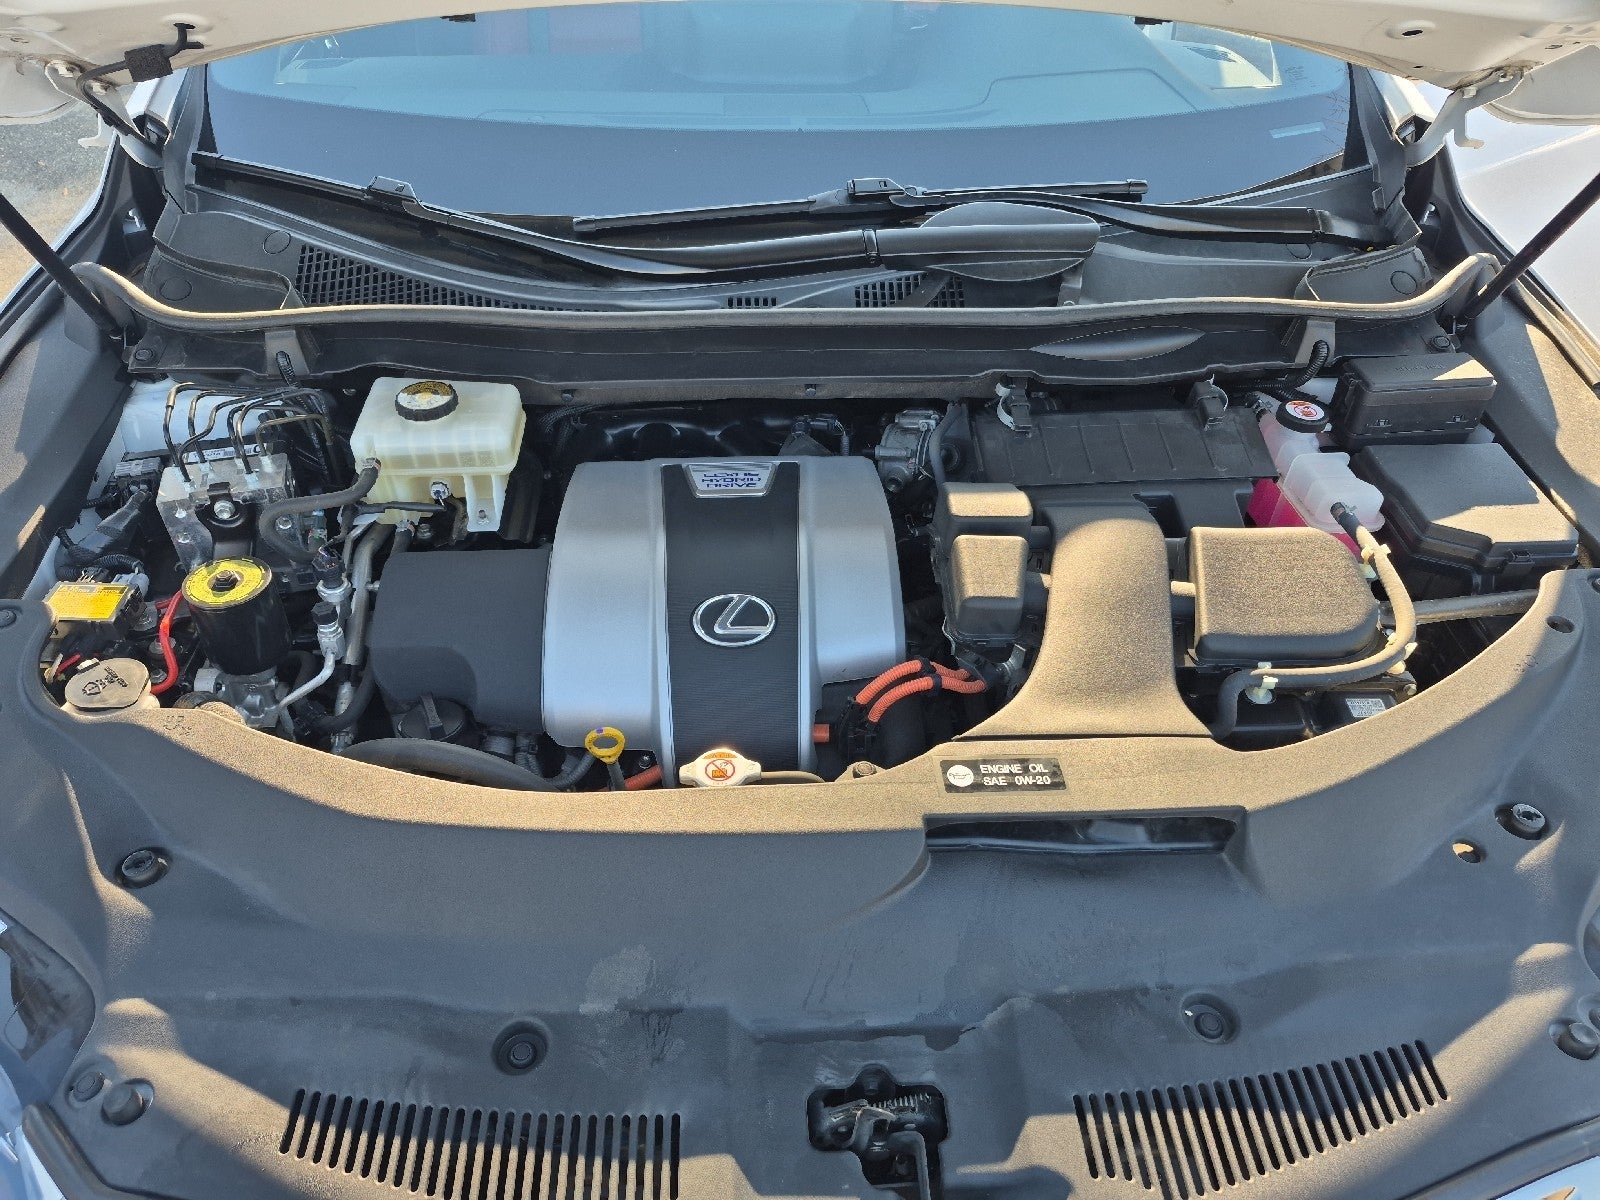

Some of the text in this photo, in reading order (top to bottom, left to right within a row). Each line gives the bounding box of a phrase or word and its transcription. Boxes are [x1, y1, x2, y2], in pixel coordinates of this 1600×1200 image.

[980, 763, 1049, 774] ENGINE OIL
[983, 775, 1051, 786] SAE 0W-20
